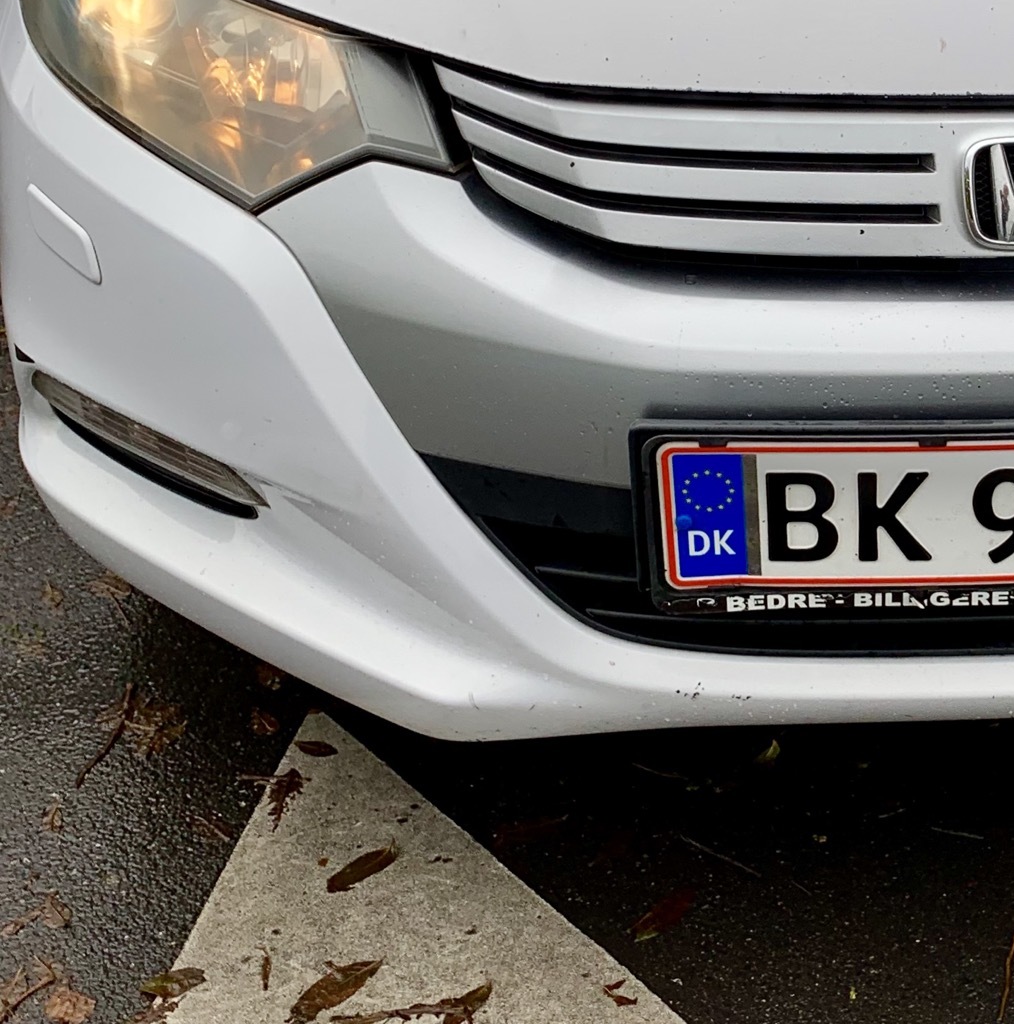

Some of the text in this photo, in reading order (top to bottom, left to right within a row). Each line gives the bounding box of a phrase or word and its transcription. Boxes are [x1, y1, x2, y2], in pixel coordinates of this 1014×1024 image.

[765, 472, 932, 562] BK
[687, 529, 736, 557] DK
[726, 593, 827, 613] BEDRE
[853, 591, 1010, 608] BILLGERE
